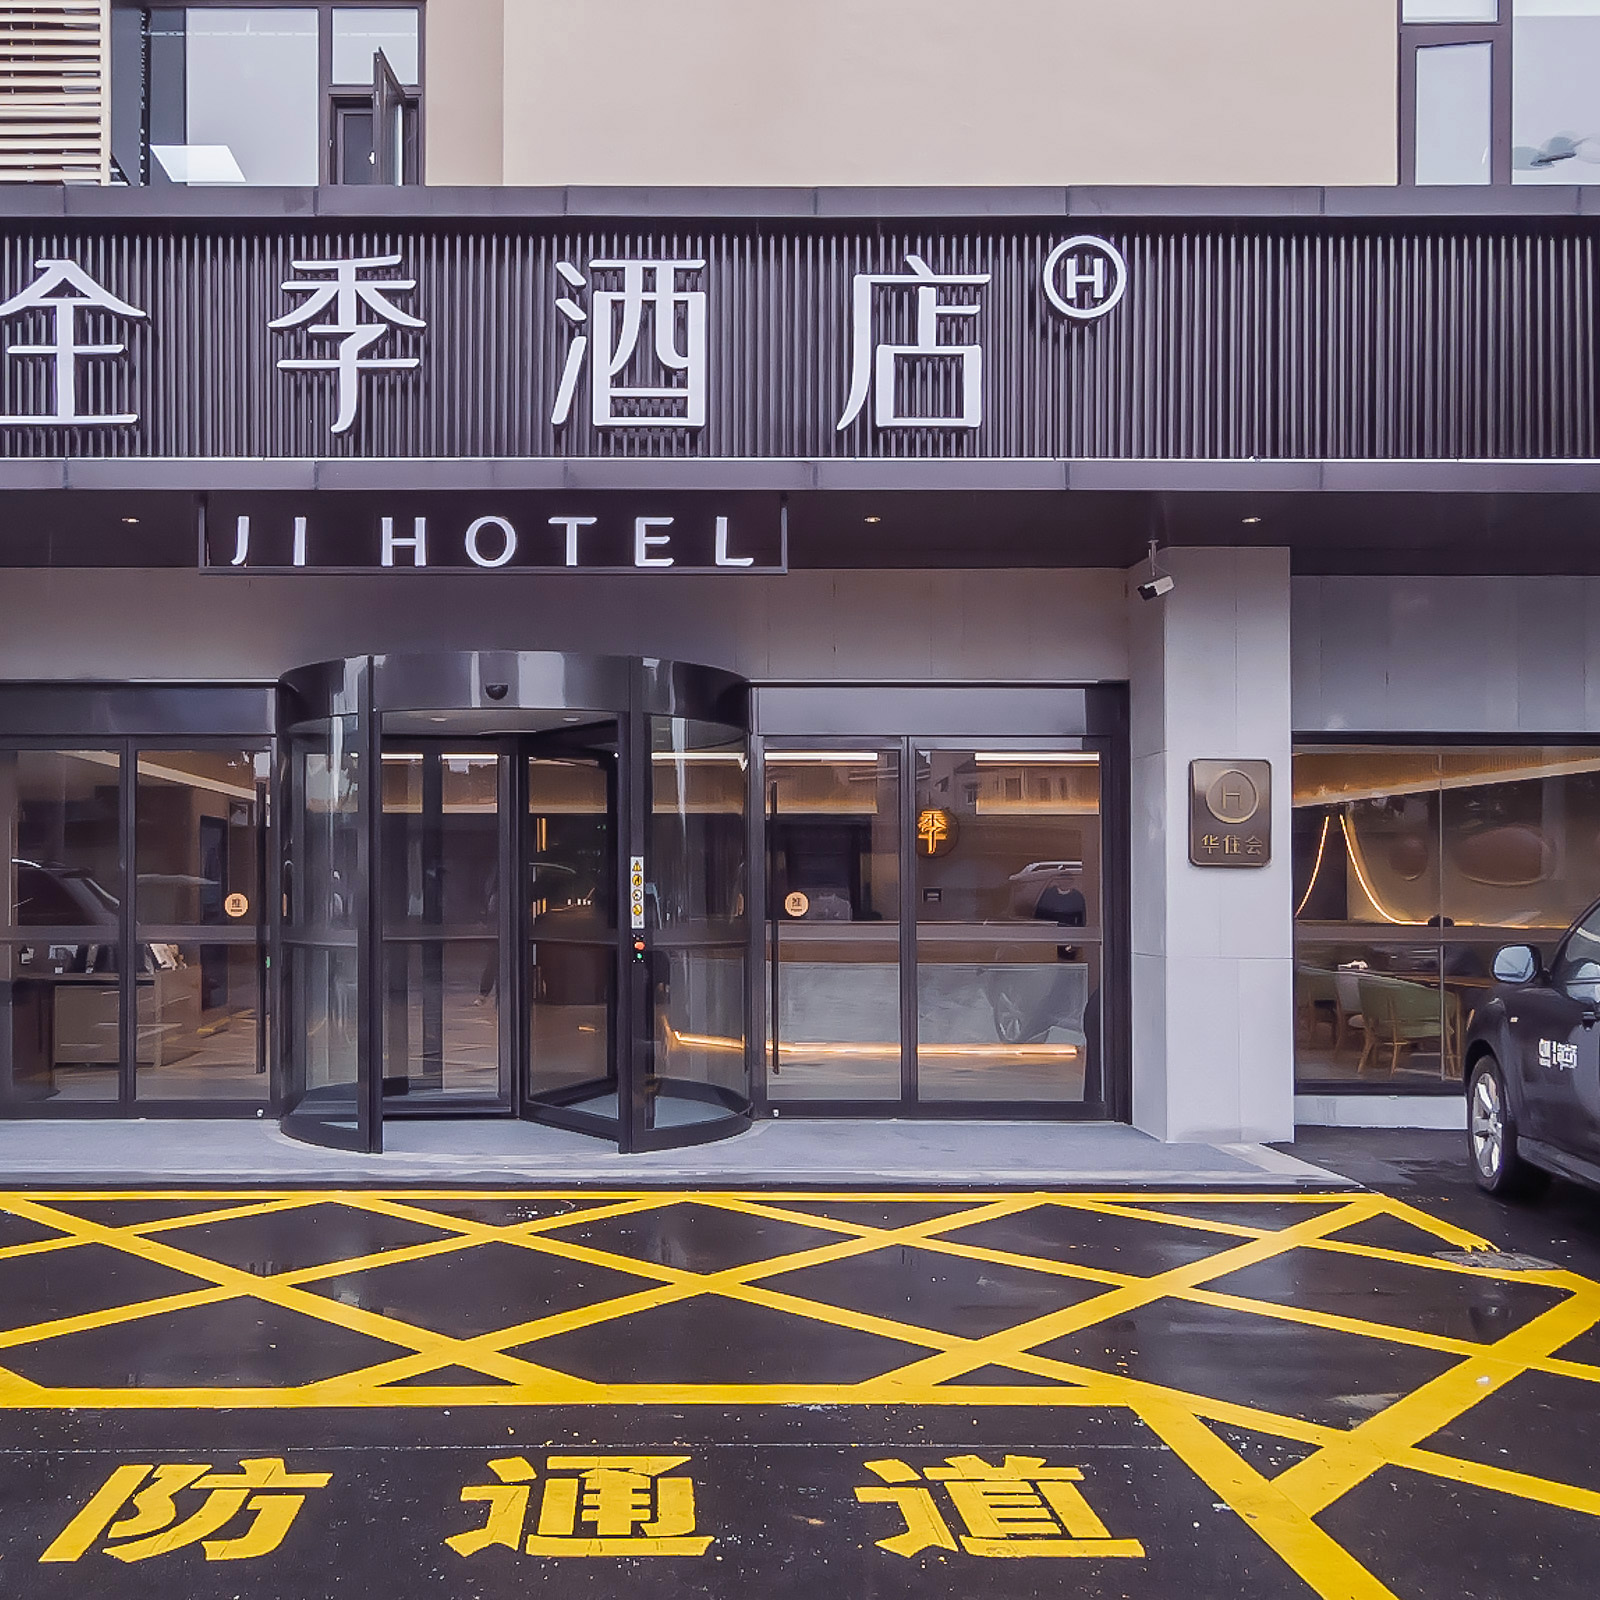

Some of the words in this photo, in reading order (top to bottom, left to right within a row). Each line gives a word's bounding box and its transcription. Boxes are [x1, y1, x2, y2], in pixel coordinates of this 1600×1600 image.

[230, 515, 307, 567] JI
[380, 514, 755, 568] HOTEL
[1201, 833, 1264, 856] 华住会
